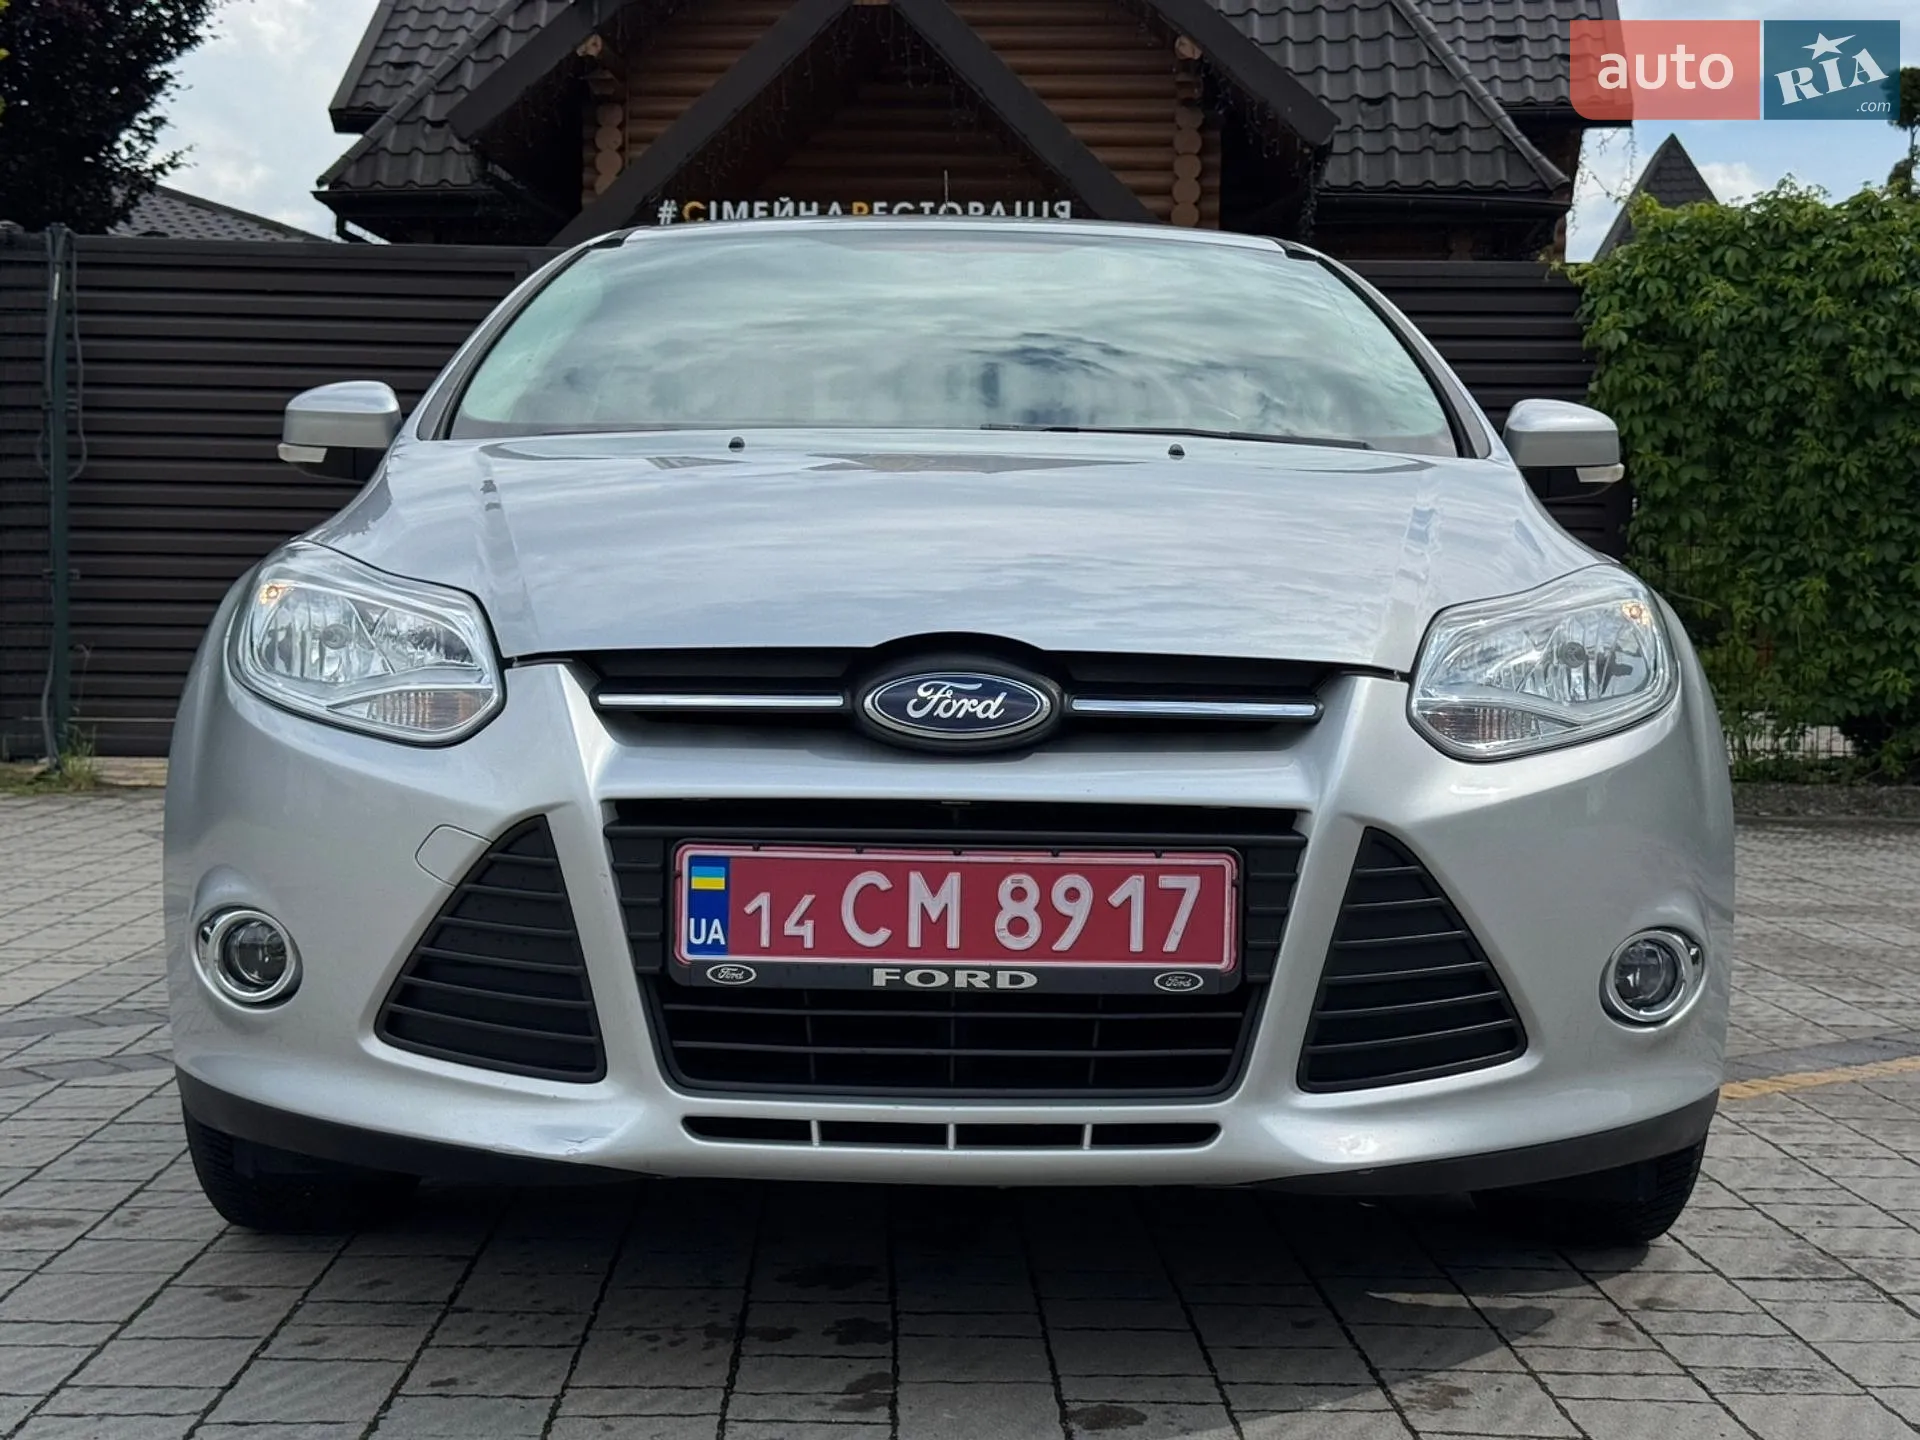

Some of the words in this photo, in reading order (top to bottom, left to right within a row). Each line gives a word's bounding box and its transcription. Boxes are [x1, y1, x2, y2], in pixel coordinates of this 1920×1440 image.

[907, 680, 1007, 720] Ford
[743, 892, 816, 949] 14
[841, 870, 961, 949] CM
[994, 873, 1201, 953] 8917
[689, 917, 726, 946] UA
[872, 967, 1038, 990] FORD
